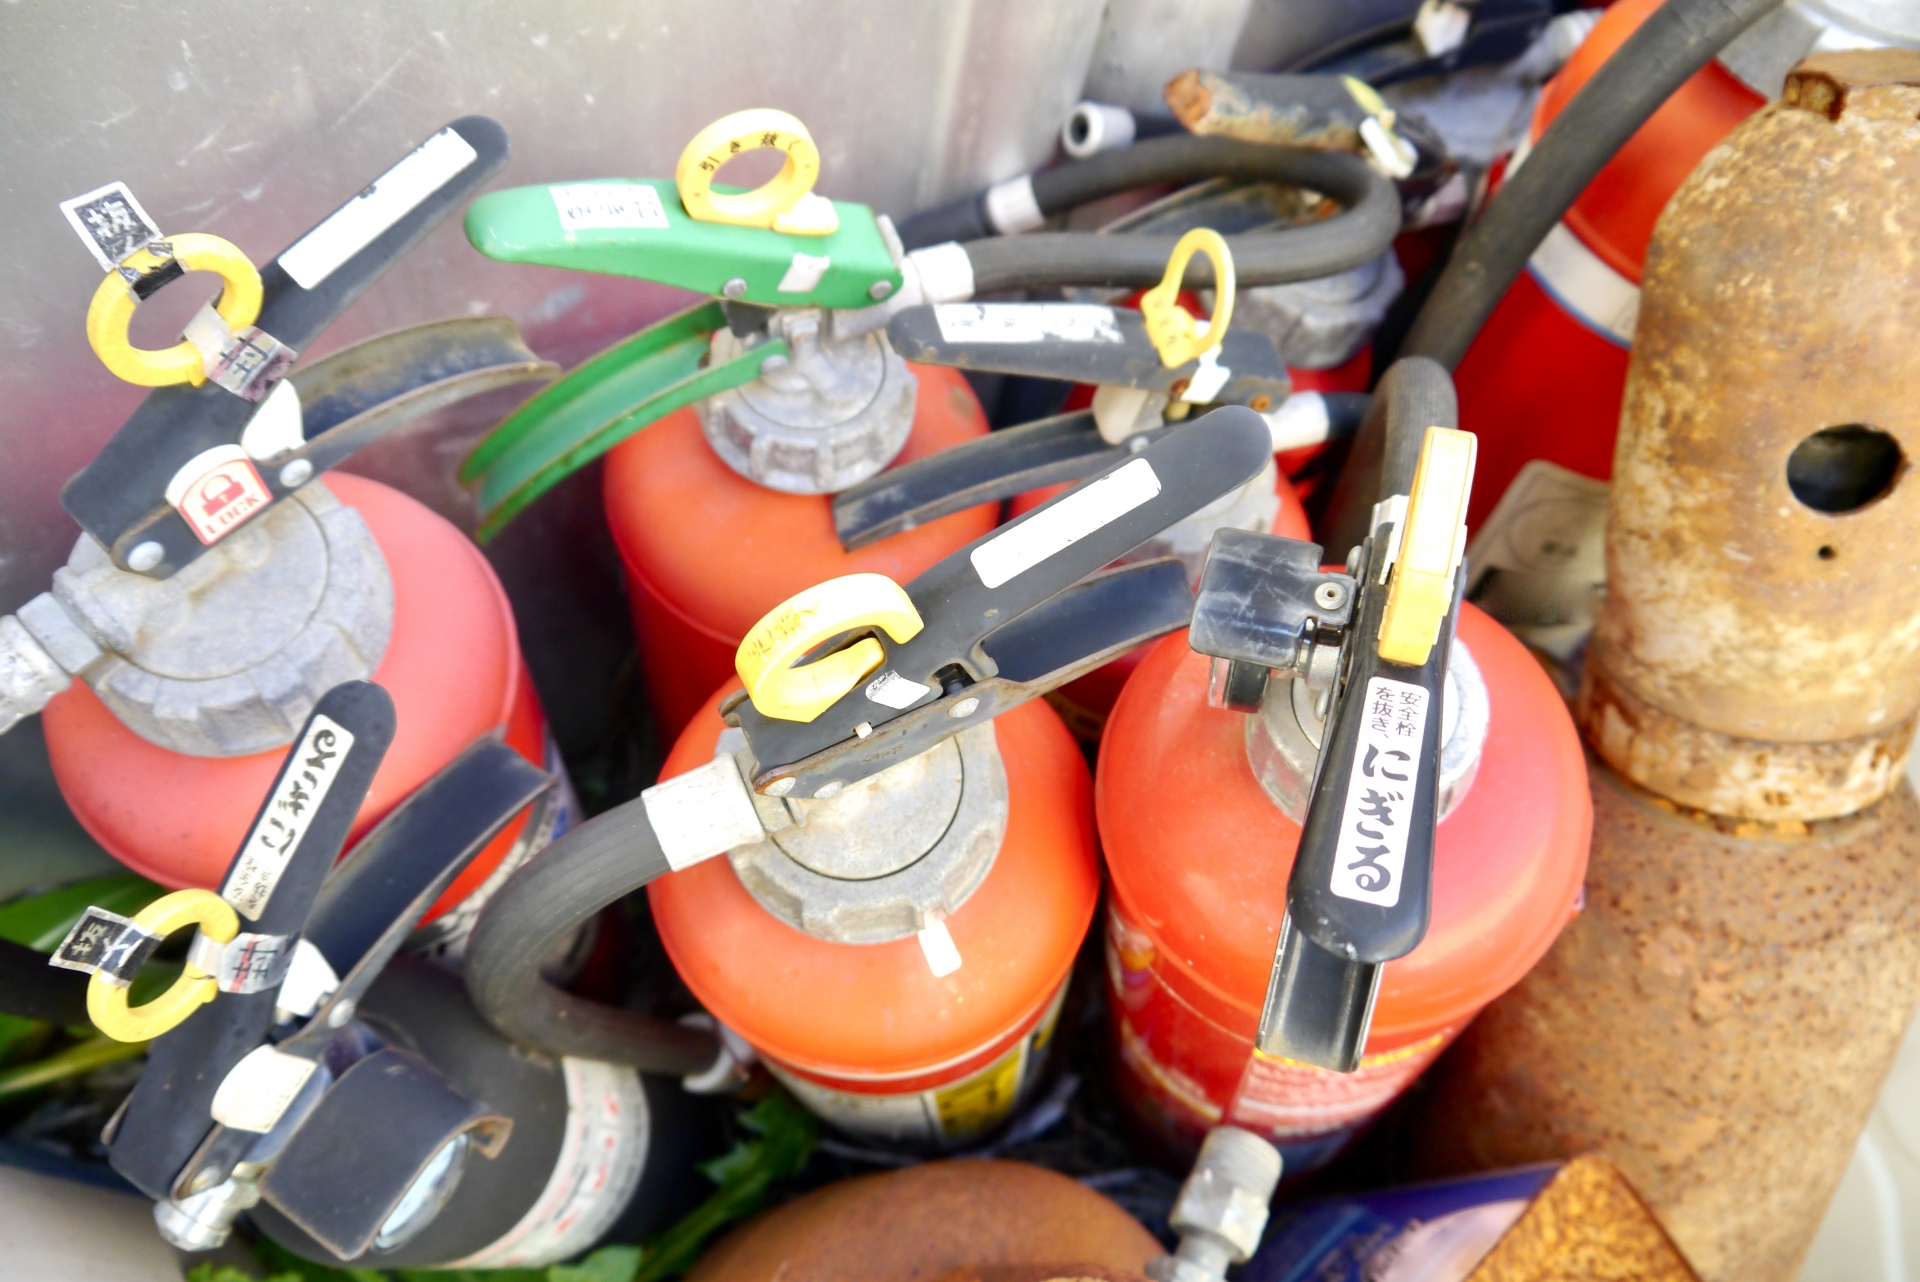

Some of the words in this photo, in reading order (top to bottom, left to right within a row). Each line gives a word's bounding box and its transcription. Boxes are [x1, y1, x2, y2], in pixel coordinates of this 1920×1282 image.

[204, 492, 260, 535] LOCK
[1395, 691, 1422, 738] 安全栓
[261, 729, 337, 857] にぎる
[1347, 743, 1411, 892] にぎる
[71, 921, 130, 958] 抜く
